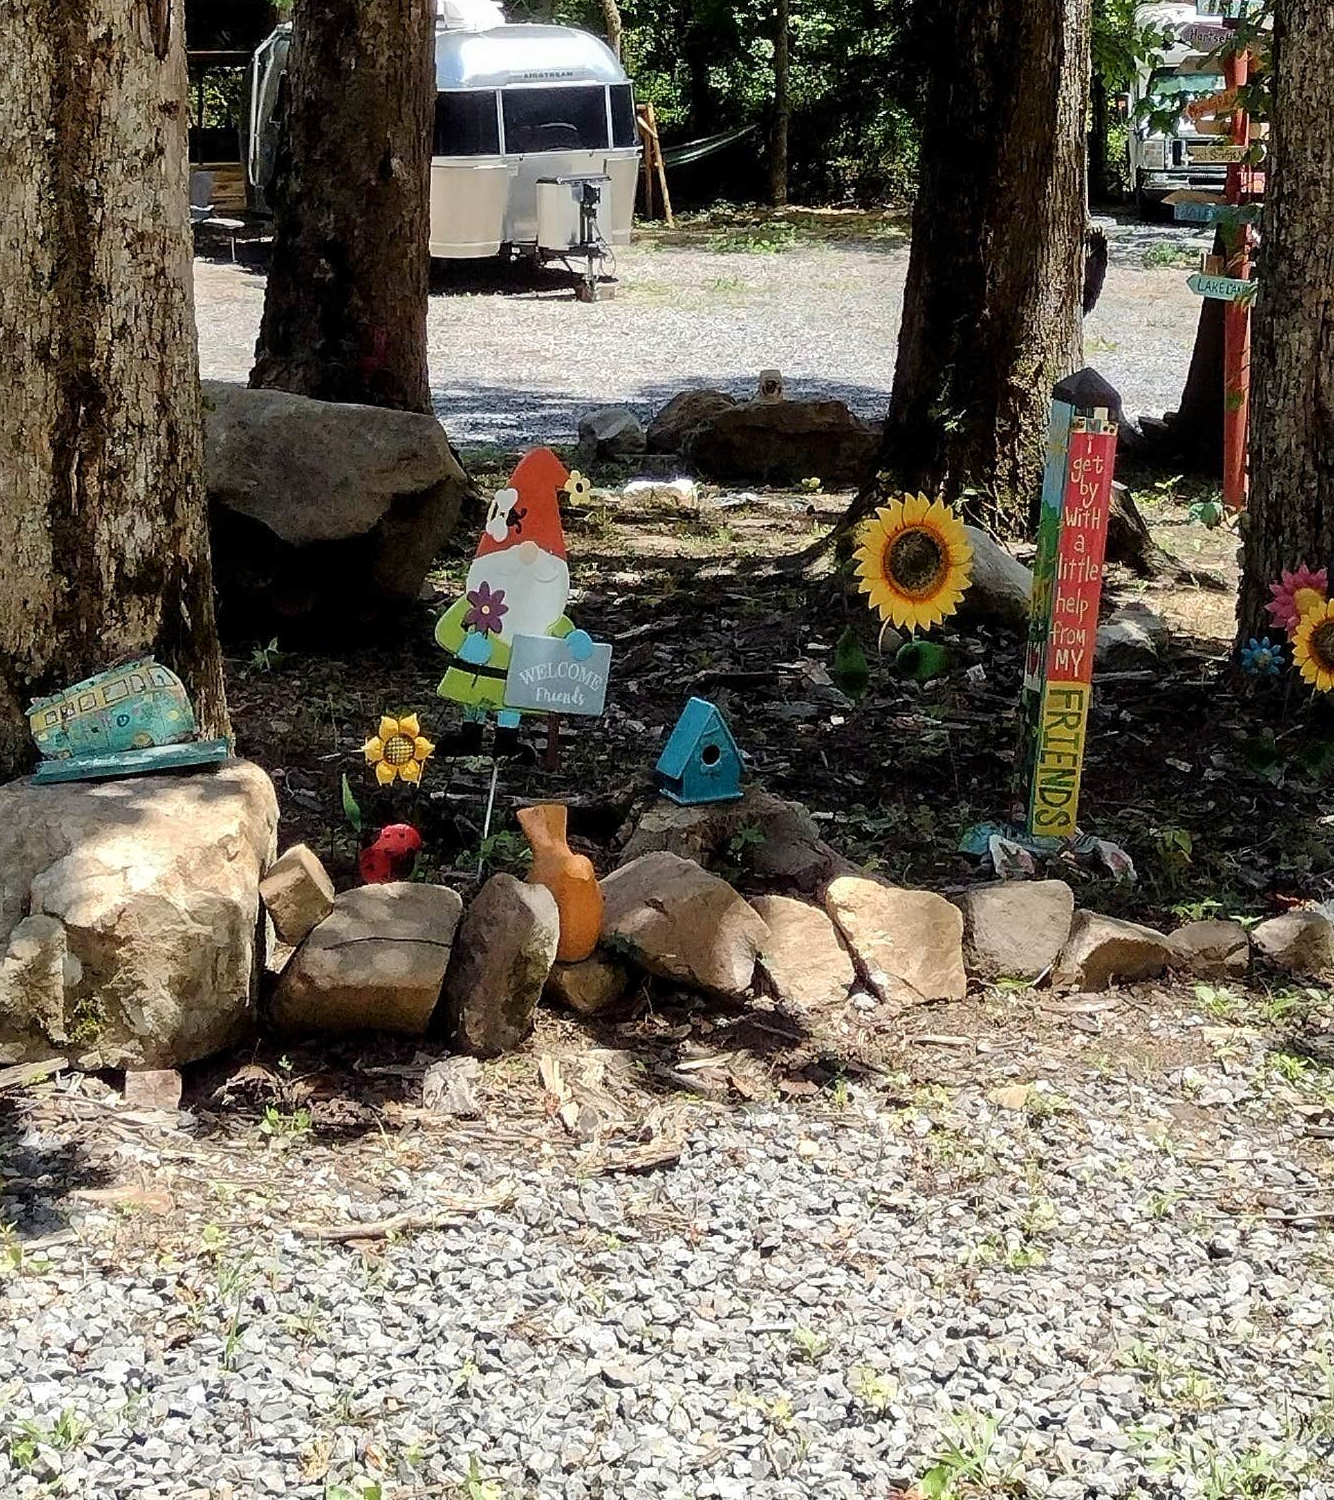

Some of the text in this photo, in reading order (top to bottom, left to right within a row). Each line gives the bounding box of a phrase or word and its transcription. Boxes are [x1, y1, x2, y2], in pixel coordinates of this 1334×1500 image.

[1071, 455, 1104, 483] get
[1080, 475, 1099, 508] by
[1073, 534, 1085, 553] a
[1058, 552, 1099, 583] little
[1056, 585, 1089, 625] help
[519, 661, 602, 691] WELCOME
[1055, 649, 1084, 677] MY
[536, 685, 586, 706] Friends
[1035, 688, 1084, 827] FRIENDS
